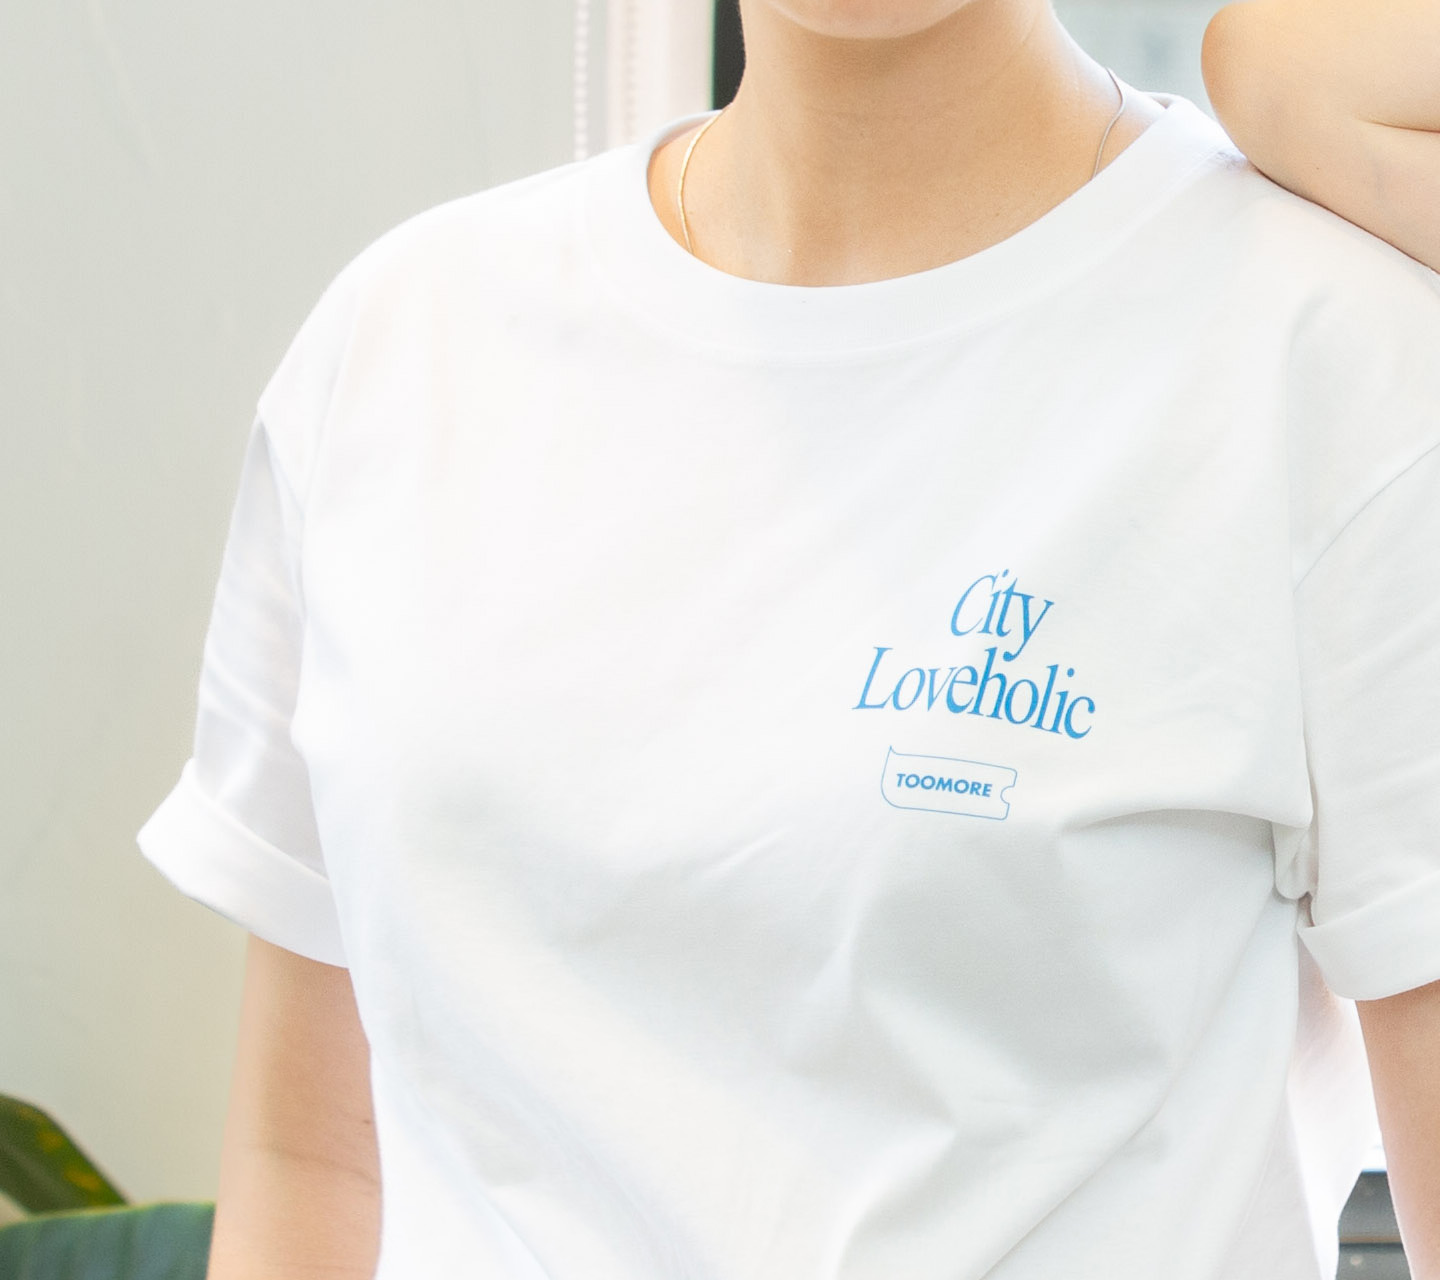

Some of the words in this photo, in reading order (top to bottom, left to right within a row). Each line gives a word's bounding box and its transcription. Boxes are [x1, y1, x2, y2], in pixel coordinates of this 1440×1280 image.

[951, 569, 1054, 662] City
[852, 646, 1095, 739] Loveholic
[896, 773, 992, 798] TOOMORE
